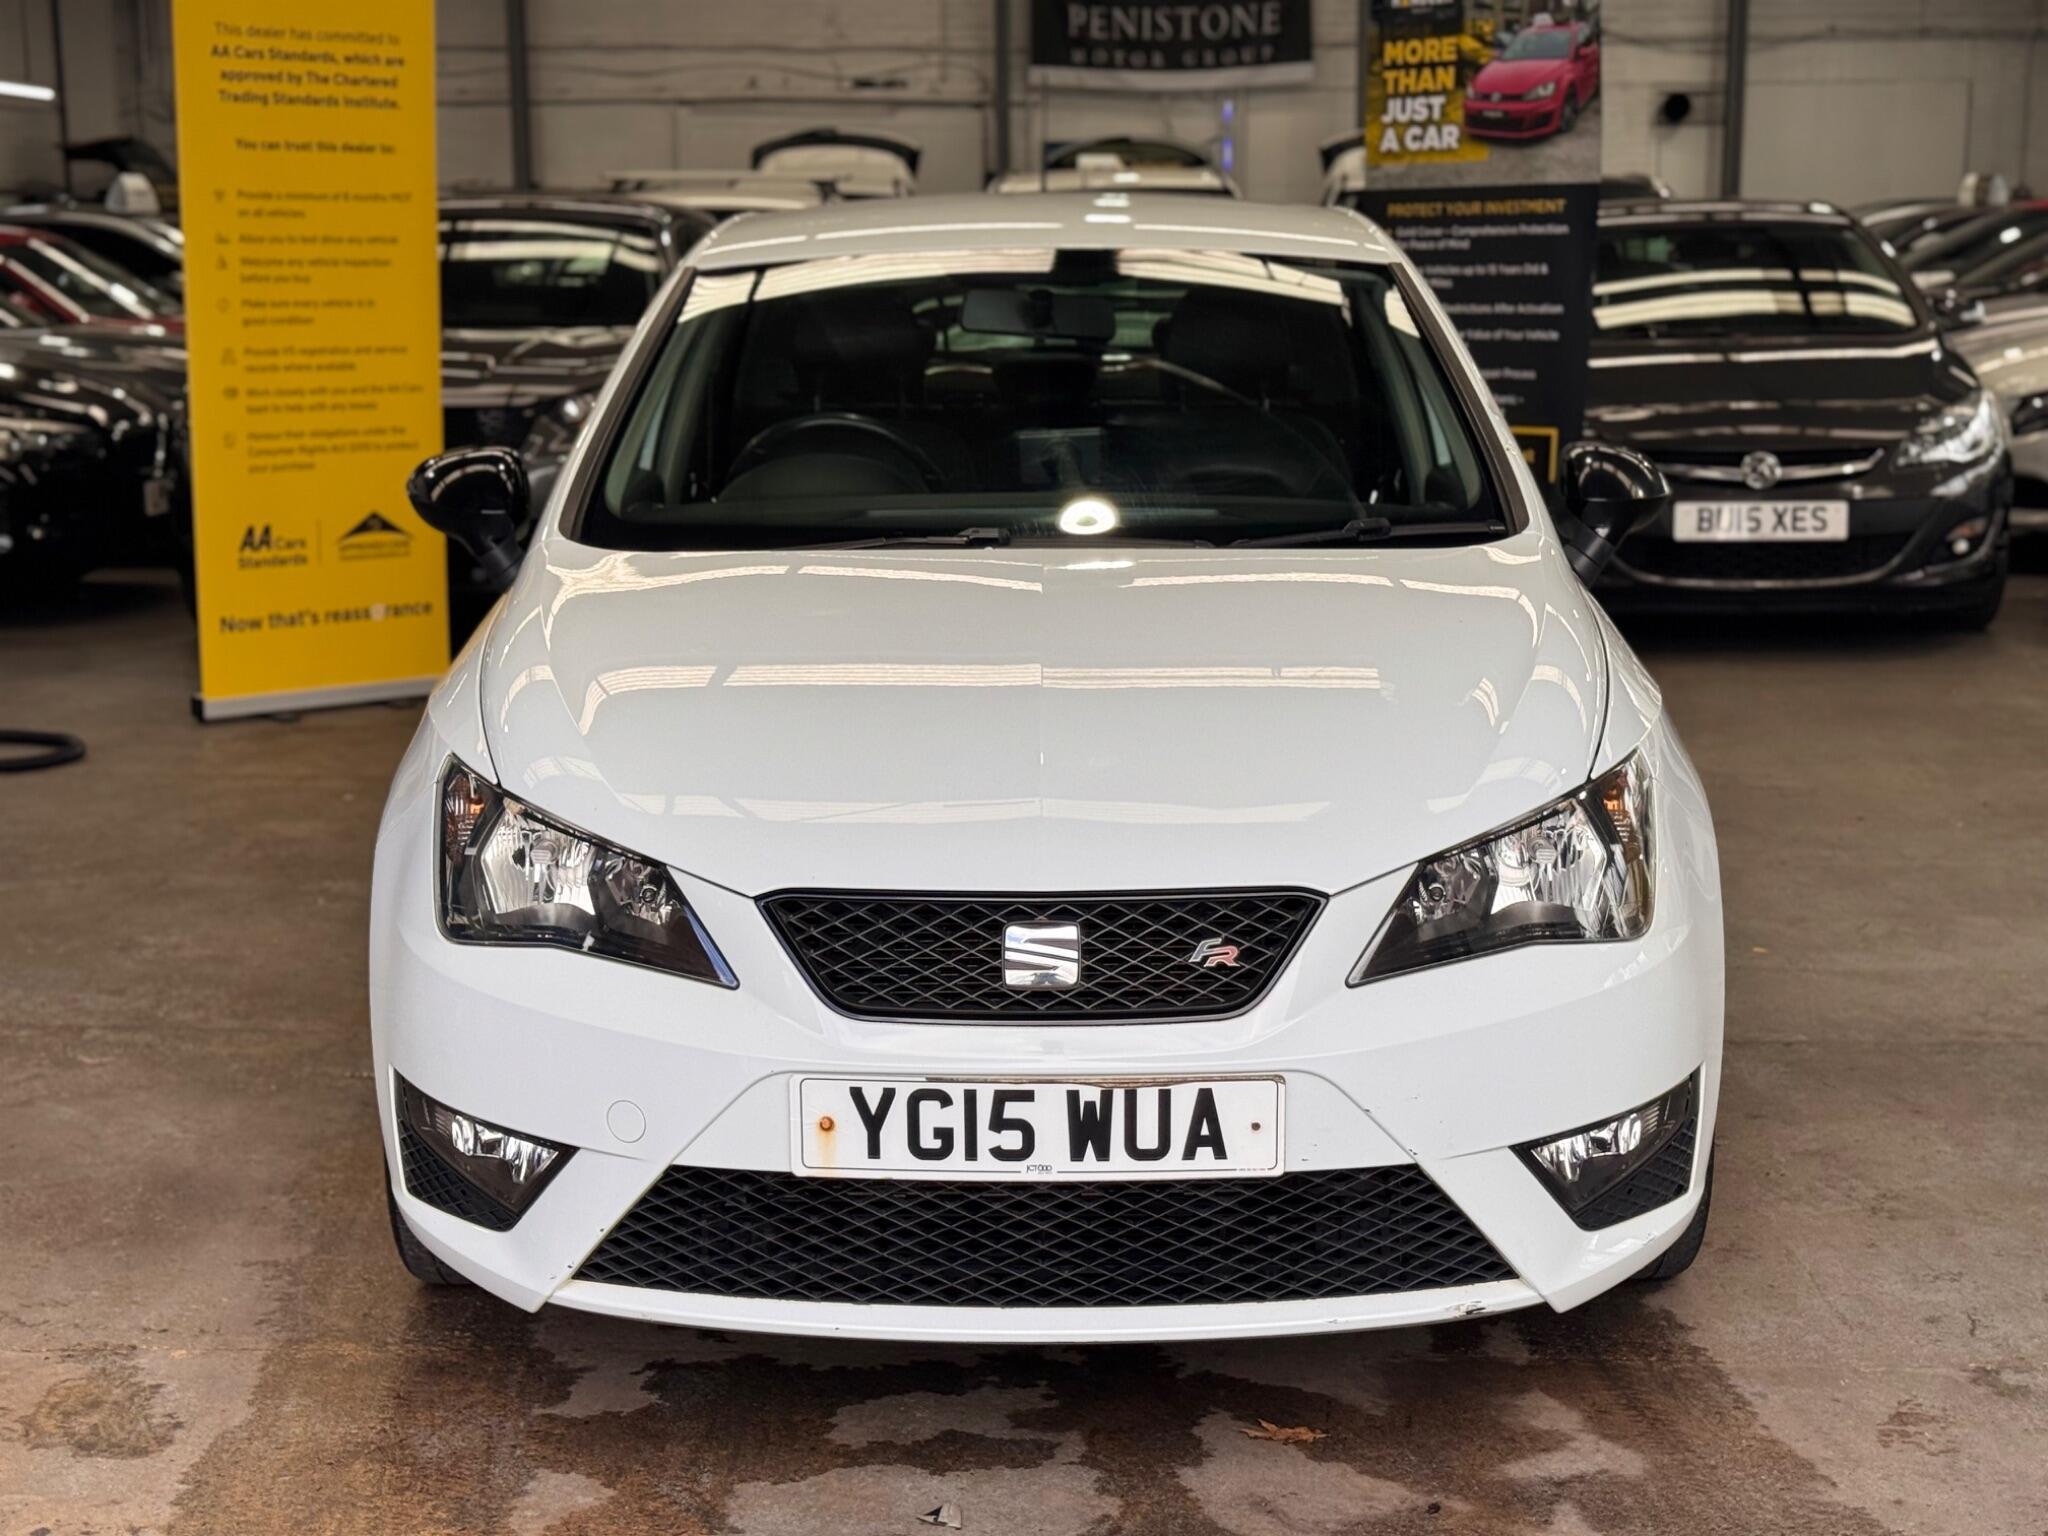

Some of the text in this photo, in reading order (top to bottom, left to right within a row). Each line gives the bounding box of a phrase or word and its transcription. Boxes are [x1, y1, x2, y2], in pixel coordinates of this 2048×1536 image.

[215, 21, 400, 46] This dealer has committed to
[1067, 1, 1280, 41] PENISTONE
[211, 44, 405, 68] AA Cars Standards, which are
[1382, 37, 1458, 66] MORE
[305, 70, 330, 84] The
[333, 72, 398, 88] Chartered
[1382, 66, 1457, 96] THAN
[218, 88, 269, 109] Trading
[272, 91, 339, 107] Standards
[1380, 95, 1447, 124] JUST
[235, 137, 258, 151] You
[1379, 122, 1461, 154] A CAR
[1387, 198, 1566, 218] PROTECT YOUR INVESTMENT
[1772, 506, 1828, 532] XES
[239, 522, 273, 552] AA
[238, 553, 309, 569] Standards
[220, 616, 263, 633] Now
[268, 607, 320, 628] that's
[1188, 938, 1240, 967] FR
[849, 1086, 1227, 1162] YG15 WUA
